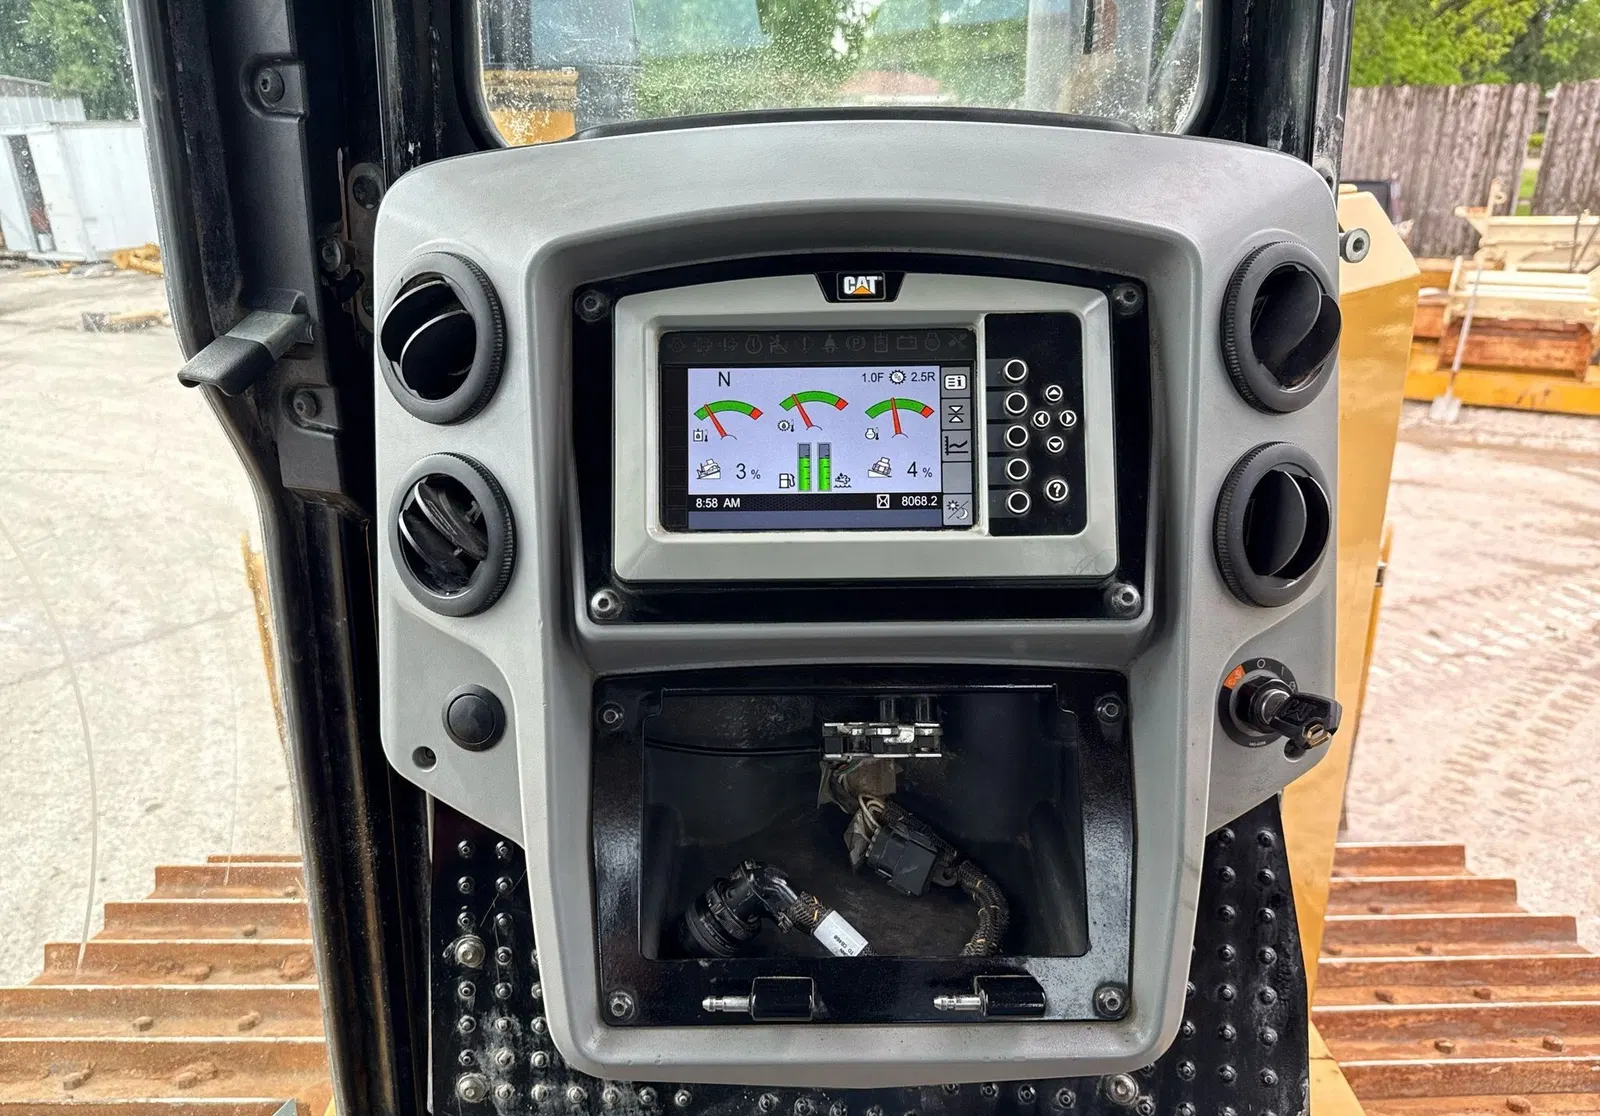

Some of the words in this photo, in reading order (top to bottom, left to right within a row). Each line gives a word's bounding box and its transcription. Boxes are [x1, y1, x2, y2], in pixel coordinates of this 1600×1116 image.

[844, 276, 878, 294] CAT
[718, 372, 731, 387] N
[862, 372, 884, 383] 1.0F
[911, 372, 936, 382] 2.5R
[736, 463, 747, 480] 3
[751, 469, 760, 480] %
[907, 461, 918, 478] 4
[922, 467, 933, 478] %
[695, 498, 718, 508] 8:58
[723, 498, 740, 508] AM
[901, 496, 938, 506] 8068.2
